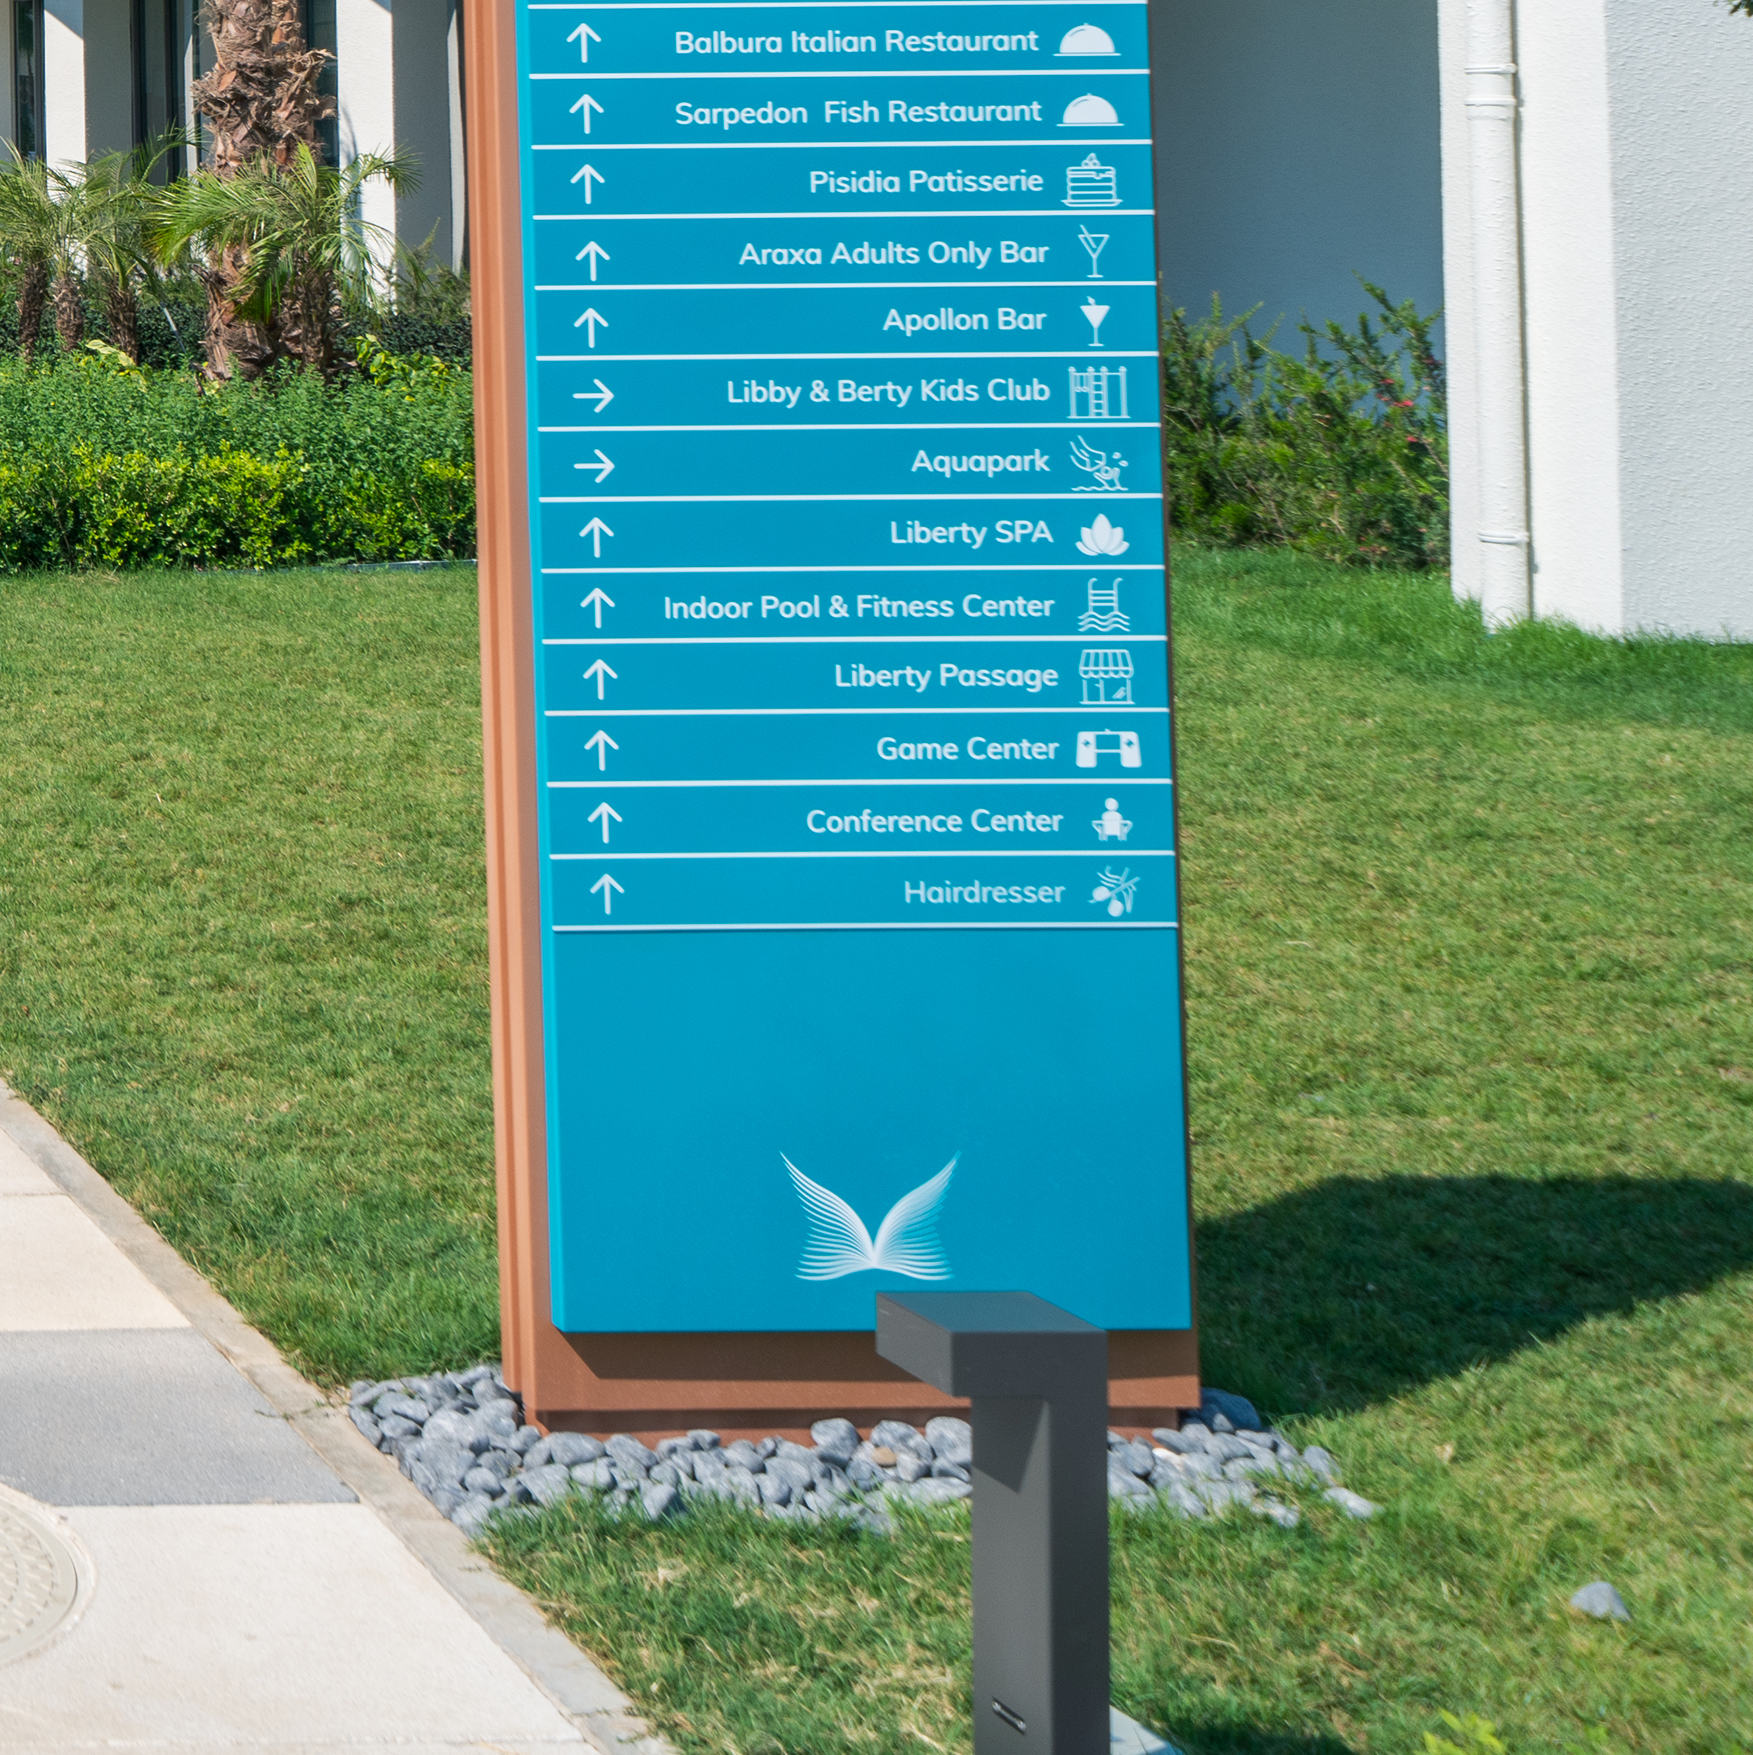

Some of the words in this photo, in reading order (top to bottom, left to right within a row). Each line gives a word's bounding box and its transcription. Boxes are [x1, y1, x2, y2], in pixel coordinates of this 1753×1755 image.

[675, 30, 783, 54] Balbura
[791, 29, 877, 53] Italian
[885, 29, 1040, 53] Restaurant
[675, 100, 808, 131] Sarpedon
[824, 99, 880, 124] Fish
[888, 99, 1043, 123] Restaurant
[810, 169, 901, 194] Pisidia
[909, 168, 1044, 193] Patisserie
[738, 242, 823, 266] Araxa
[830, 240, 921, 265] Adults
[928, 240, 992, 270] Only
[1000, 240, 1050, 264] Bar
[882, 307, 989, 337] Apollon
[997, 307, 1048, 331] Bar
[727, 379, 803, 409] Libby
[809, 379, 831, 403] &
[837, 379, 913, 408] Berty
[921, 378, 980, 402] Kids
[987, 377, 1051, 402] Club
[911, 448, 1051, 479] Aquapark
[890, 520, 988, 550] Liberty
[995, 519, 1054, 544] SPA
[664, 595, 754, 620] Indoor
[761, 594, 821, 619] Pool
[828, 594, 850, 618] &
[857, 594, 955, 618] Fitness
[962, 593, 1056, 618] Center
[835, 663, 932, 693] Liberty
[939, 663, 1059, 693] Passage
[876, 736, 960, 761] Game
[966, 736, 1060, 761] Center
[806, 808, 963, 834] Conference
[970, 808, 1064, 833] Center
[904, 879, 1066, 904] Hairdresser
